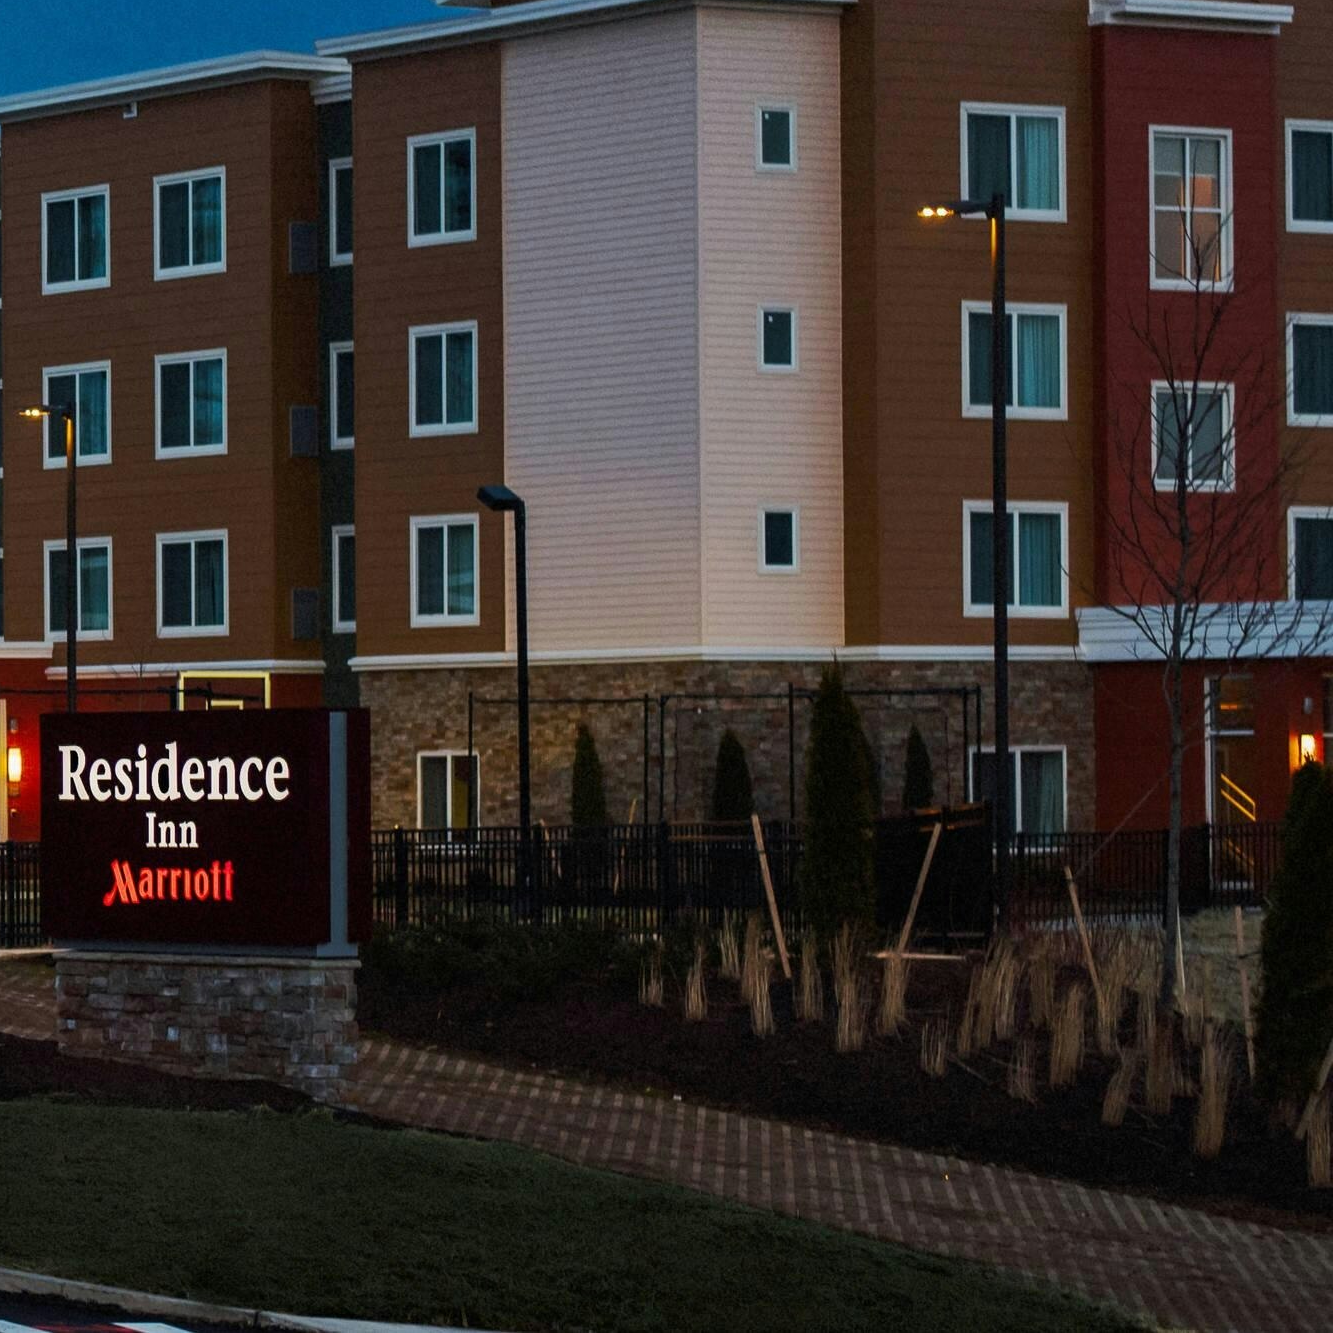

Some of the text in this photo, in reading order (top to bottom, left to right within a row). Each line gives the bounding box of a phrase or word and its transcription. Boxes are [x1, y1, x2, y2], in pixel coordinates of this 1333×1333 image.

[58, 741, 290, 802] Residence
[146, 812, 199, 848] Inn
[103, 859, 235, 906] Marriott
